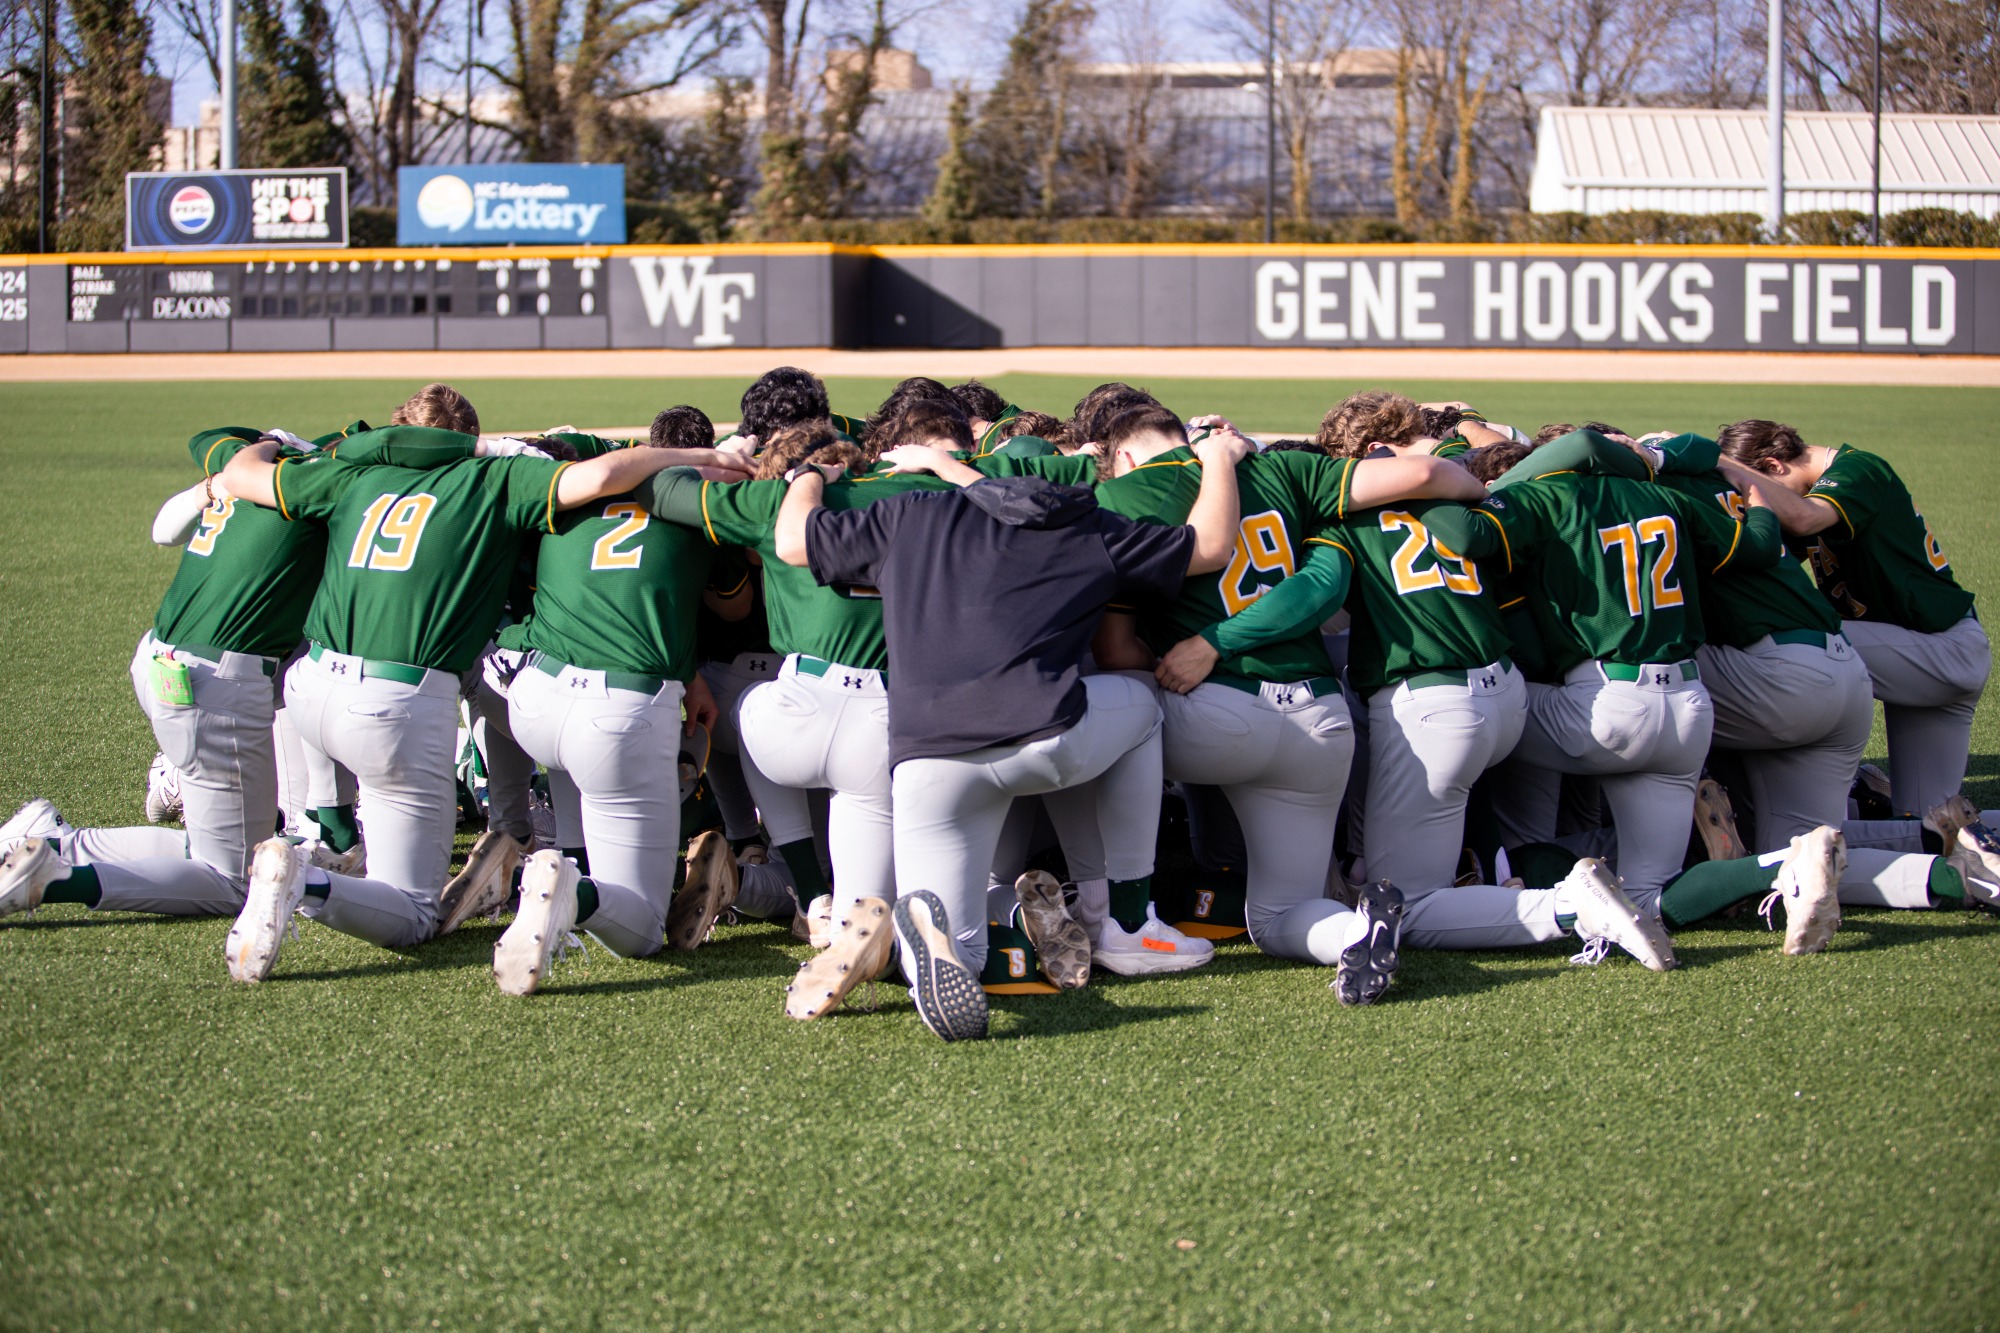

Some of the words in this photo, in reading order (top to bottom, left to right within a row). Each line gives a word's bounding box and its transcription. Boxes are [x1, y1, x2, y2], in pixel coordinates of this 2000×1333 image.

[252, 178, 287, 197] HIT
[288, 177, 329, 196] THE
[474, 197, 603, 238] Lottery
[72, 266, 103, 280] BALL
[72, 280, 116, 295] STRIKE
[152, 297, 231, 320] DEACONS
[629, 256, 755, 345] WF
[1255, 261, 1445, 341] GENE
[1474, 261, 1714, 343] HOOKS
[1744, 264, 1956, 345] FIELD
[348, 492, 437, 571] 19
[591, 502, 649, 571] 2
[1218, 509, 1295, 618] 29
[1598, 515, 1685, 617] 72
[1195, 889, 1215, 918] S
[999, 947, 1027, 978] S
